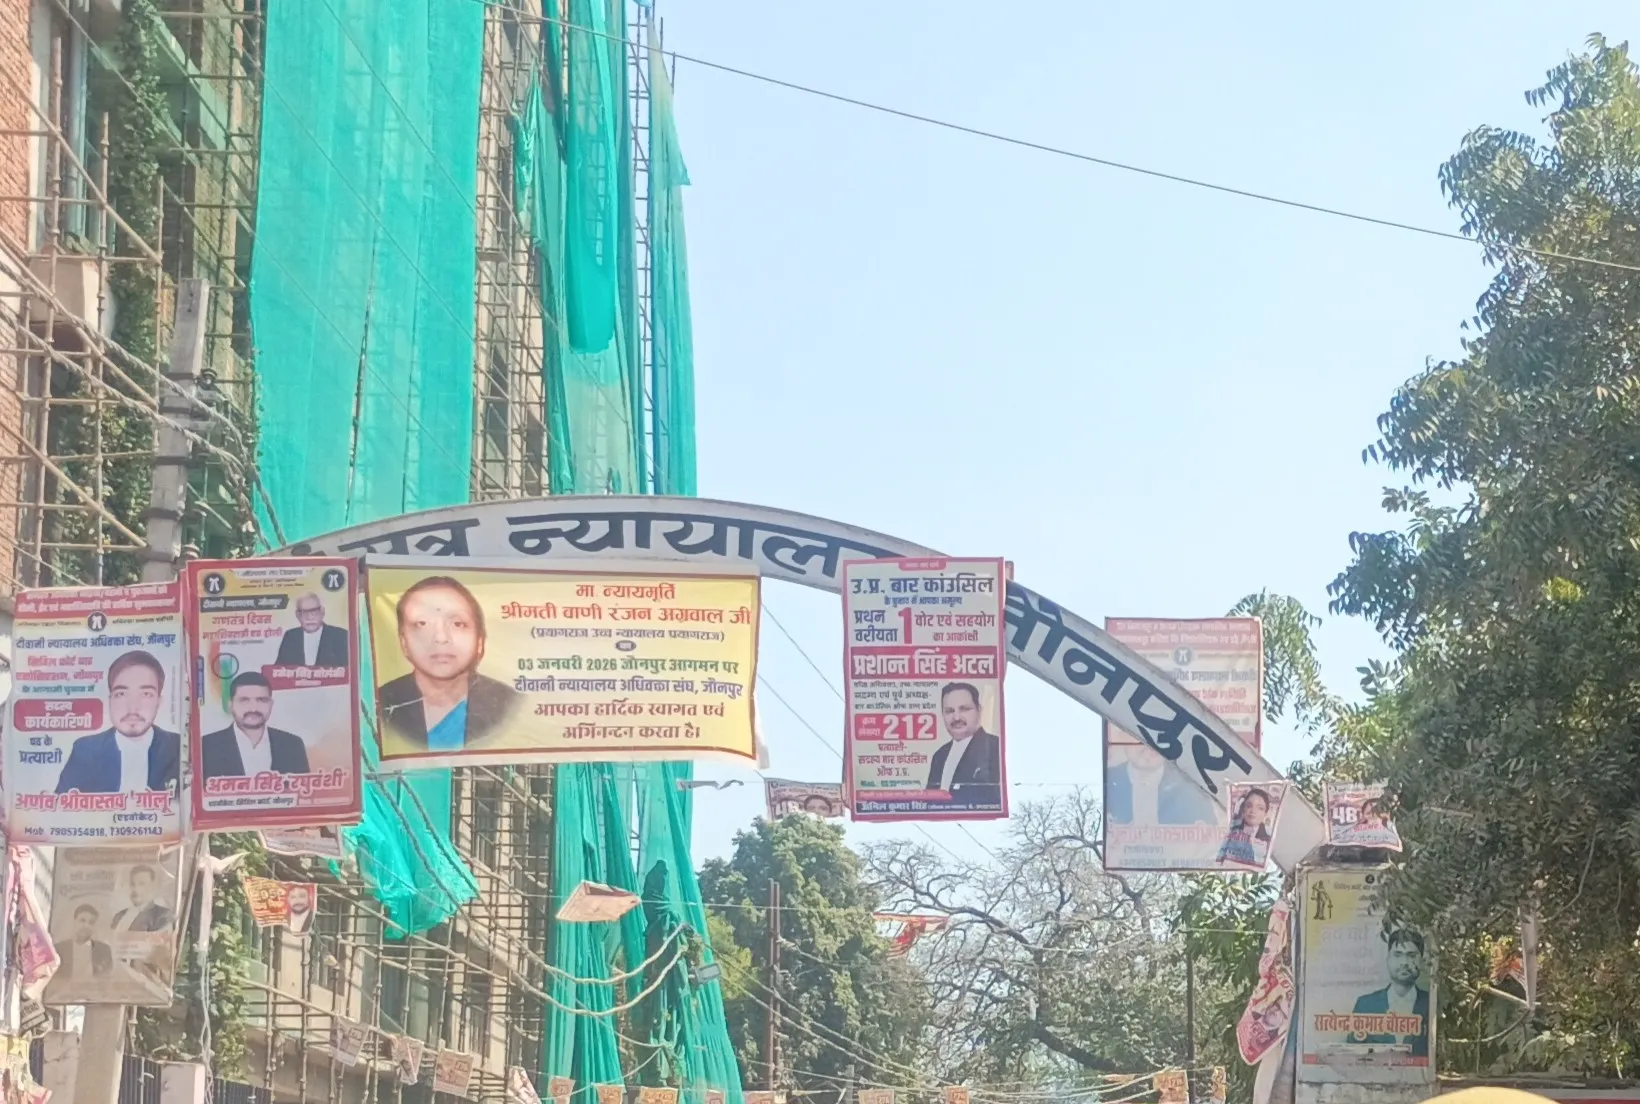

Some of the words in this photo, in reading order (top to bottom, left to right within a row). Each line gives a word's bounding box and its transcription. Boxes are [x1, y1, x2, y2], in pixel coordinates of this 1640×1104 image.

[603, 583, 676, 602] न्यायमूर्ति
[889, 577, 920, 593] बार
[500, 602, 557, 620] श्रीमती
[562, 605, 603, 621] वाणी
[607, 604, 652, 622] रंजन
[658, 607, 723, 624] अग्रवाल
[728, 607, 752, 624] जी
[914, 611, 934, 627] वोट
[955, 611, 995, 627] सहयोग
[615, 629, 665, 638] न्यायालय
[855, 625, 898, 643] वरीयता
[898, 607, 913, 645] 1
[16, 637, 45, 649] दीवानी
[47, 637, 87, 649] न्यायालय
[90, 635, 125, 646] अधिवक्ता
[147, 631, 177, 648] जौनपुर
[518, 659, 534, 671] 03
[537, 654, 582, 669] जनवरी
[586, 657, 617, 671] 2026
[620, 654, 666, 675] जौनपुर
[668, 659, 720, 672] आगमन
[722, 662, 739, 674] पर
[913, 647, 948, 675] सिंह
[952, 654, 995, 675] अटल
[514, 675, 554, 692] दीवानी
[558, 679, 617, 692] न्यायालय
[620, 676, 670, 692] अधिवक्ता
[702, 678, 743, 699] जौनपुर
[534, 704, 590, 716] आपका
[594, 698, 643, 716] हार्दिक
[648, 704, 697, 716] स्वागत
[703, 701, 725, 717] एवं
[24, 712, 93, 729] कार्यकारिणी
[882, 714, 934, 739] 212
[562, 723, 634, 739] अभिनन्दन
[638, 727, 680, 739] करता
[19, 748, 62, 764] प्रत्याशी
[207, 776, 251, 792] अमन
[253, 772, 285, 792] सिंह
[16, 790, 57, 811] अर्णव
[59, 788, 127, 810] श्रीवास्तव
[1332, 806, 1358, 823] 48
[1353, 1015, 1384, 1038] कुमार
[1386, 1011, 1419, 1033] चौहान
